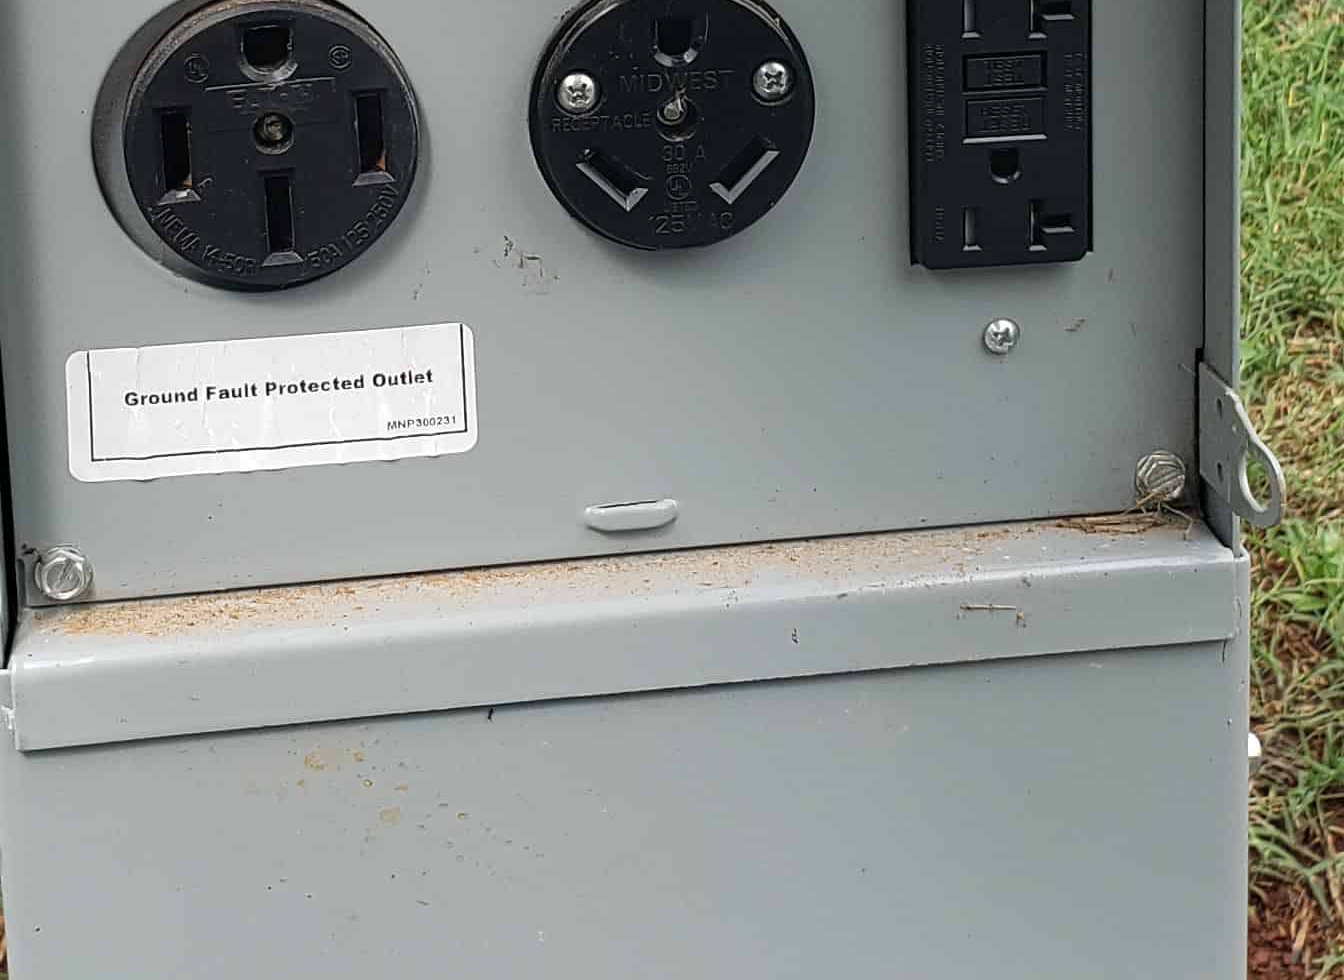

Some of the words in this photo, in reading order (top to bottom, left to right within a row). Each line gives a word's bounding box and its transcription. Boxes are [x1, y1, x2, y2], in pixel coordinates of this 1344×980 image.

[618, 69, 737, 94] MIDWEST
[124, 388, 199, 406] Ground
[206, 384, 258, 400] Fault
[265, 376, 364, 395] Protected
[372, 370, 433, 387] Outlet
[387, 416, 456, 429] MNP300231
